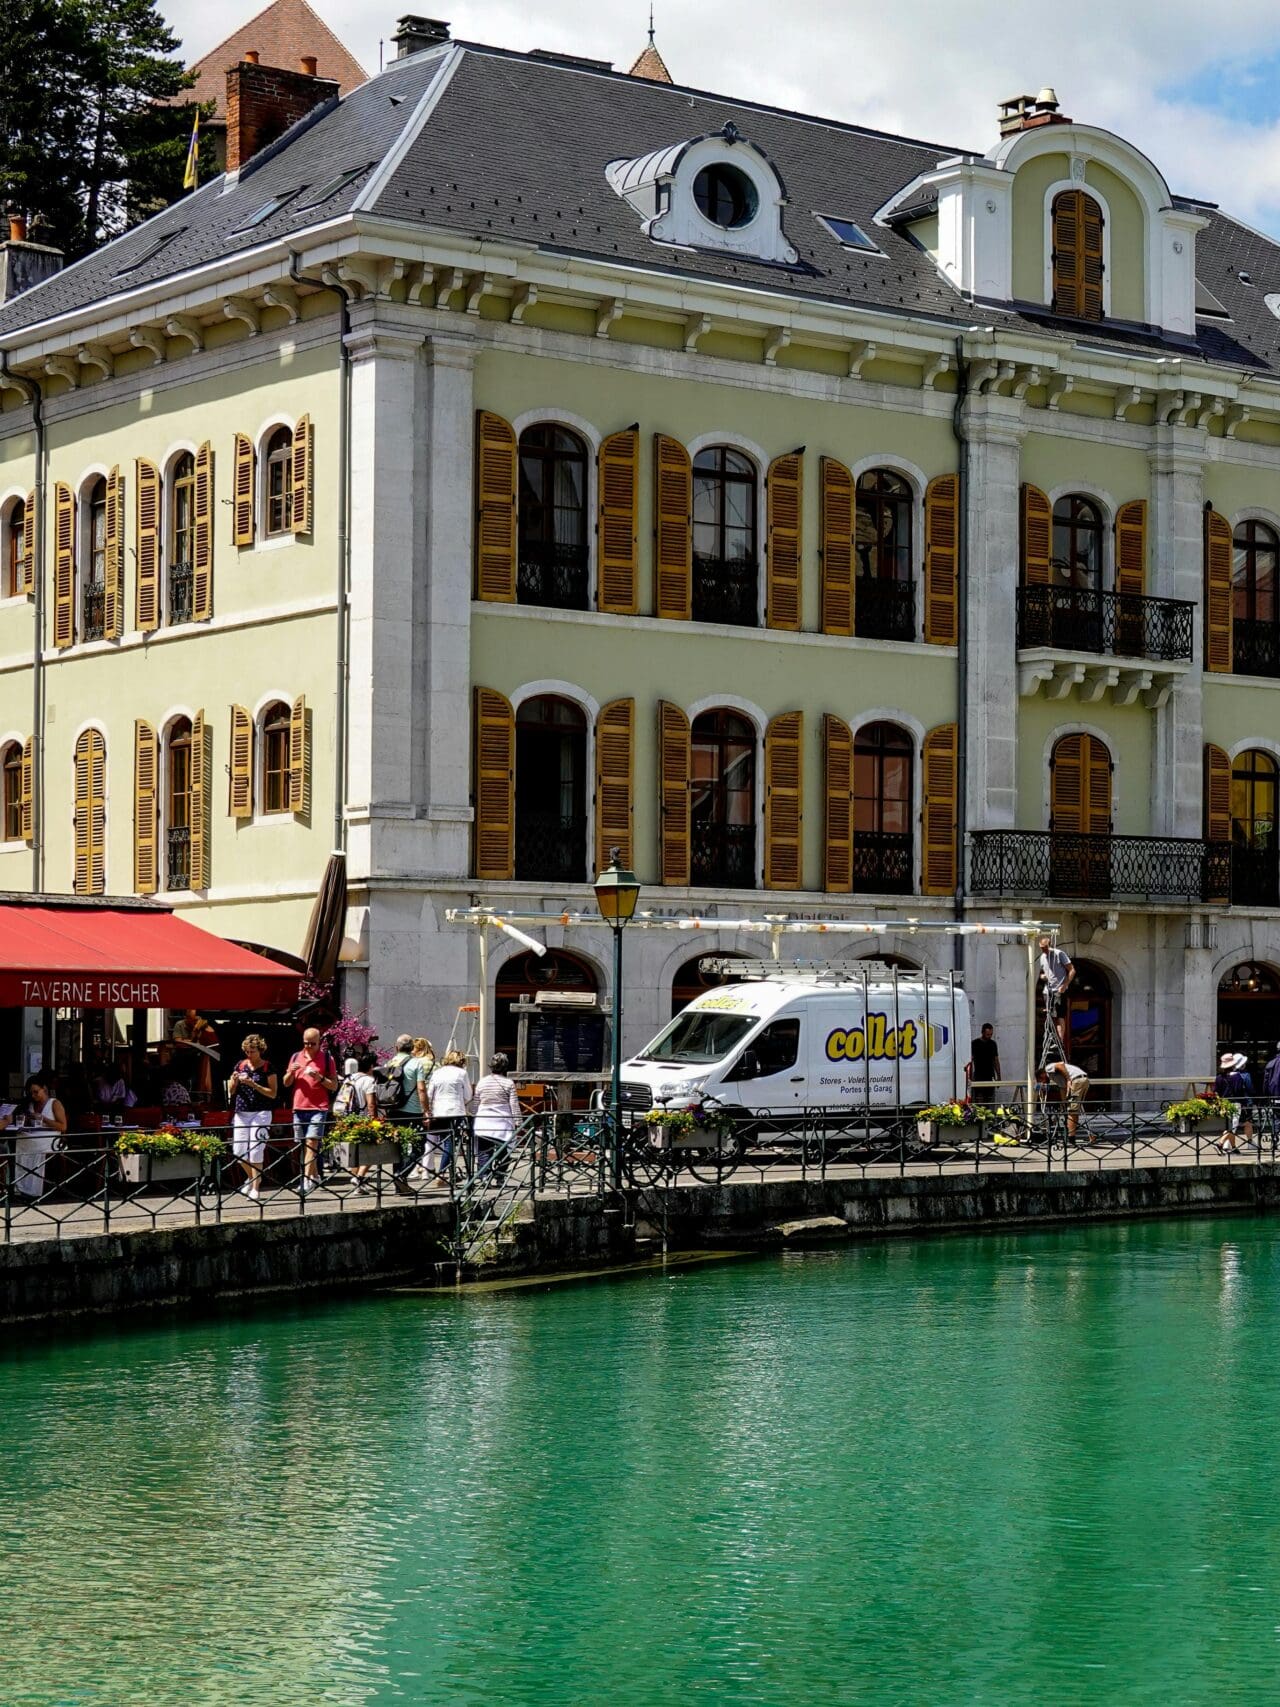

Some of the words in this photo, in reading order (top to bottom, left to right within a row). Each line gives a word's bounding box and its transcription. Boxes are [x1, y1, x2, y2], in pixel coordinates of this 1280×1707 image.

[21, 981, 93, 1002] TAVERNE
[99, 983, 160, 1003] FISCHER
[825, 1012, 917, 1062] collet
[820, 1077, 841, 1085] Stores
[869, 1075, 893, 1083] roulant
[840, 1086, 862, 1094] Portes
[873, 1084, 893, 1094] Garag
